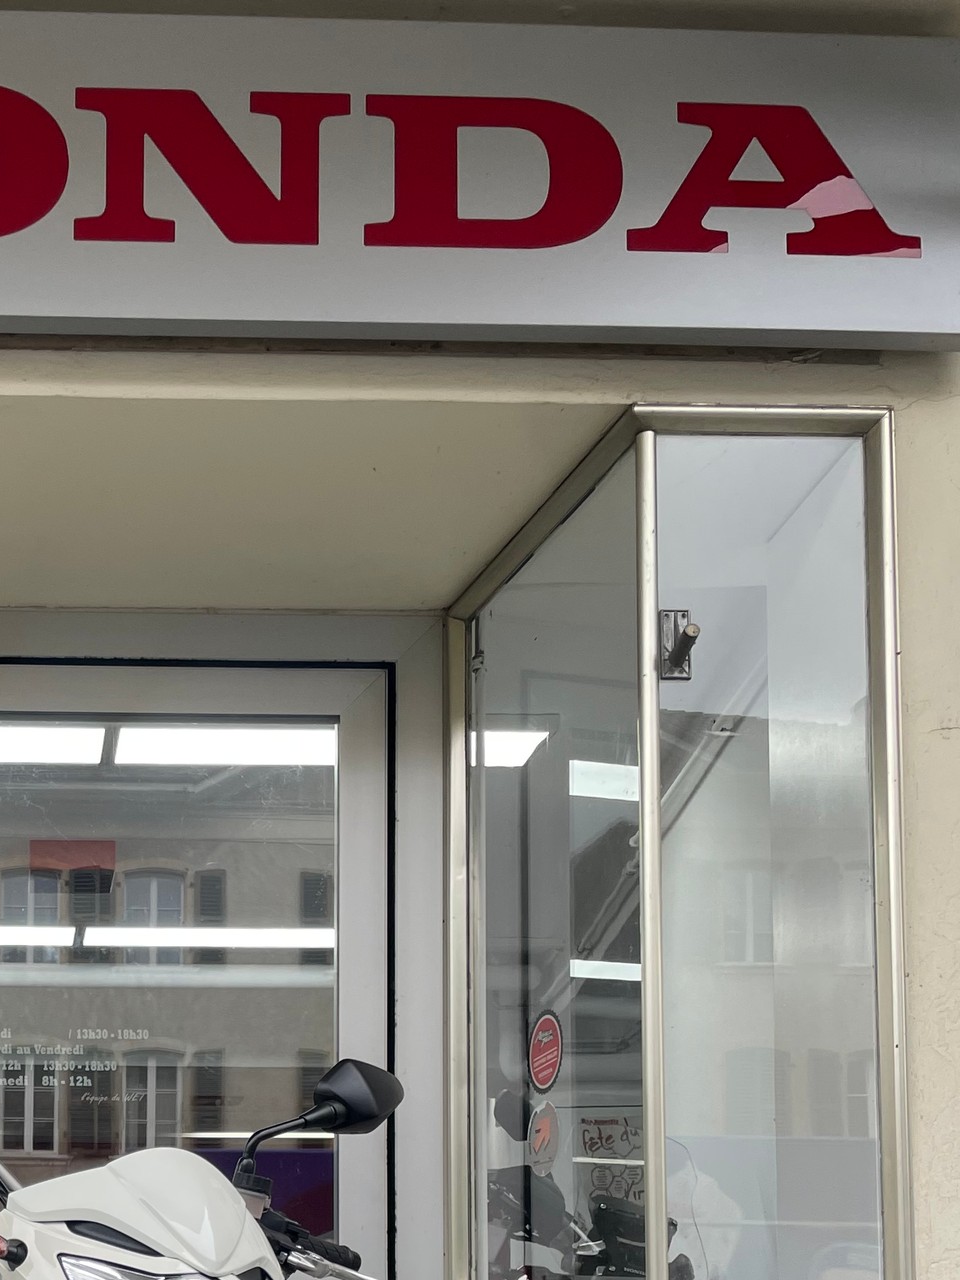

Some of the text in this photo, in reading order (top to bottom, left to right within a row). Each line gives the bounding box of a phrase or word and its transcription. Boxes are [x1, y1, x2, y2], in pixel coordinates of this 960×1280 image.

[76, 1029, 108, 1040] 13h30
[117, 1029, 149, 1040] 18h30
[16, 1047, 31, 1055] au
[33, 1044, 84, 1056] Vendredi
[1, 1060, 22, 1071] 12h
[42, 1061, 75, 1071] 13h30
[84, 1061, 117, 1071] 18h30
[41, 1076, 58, 1086] 8h
[69, 1076, 92, 1086] 12h
